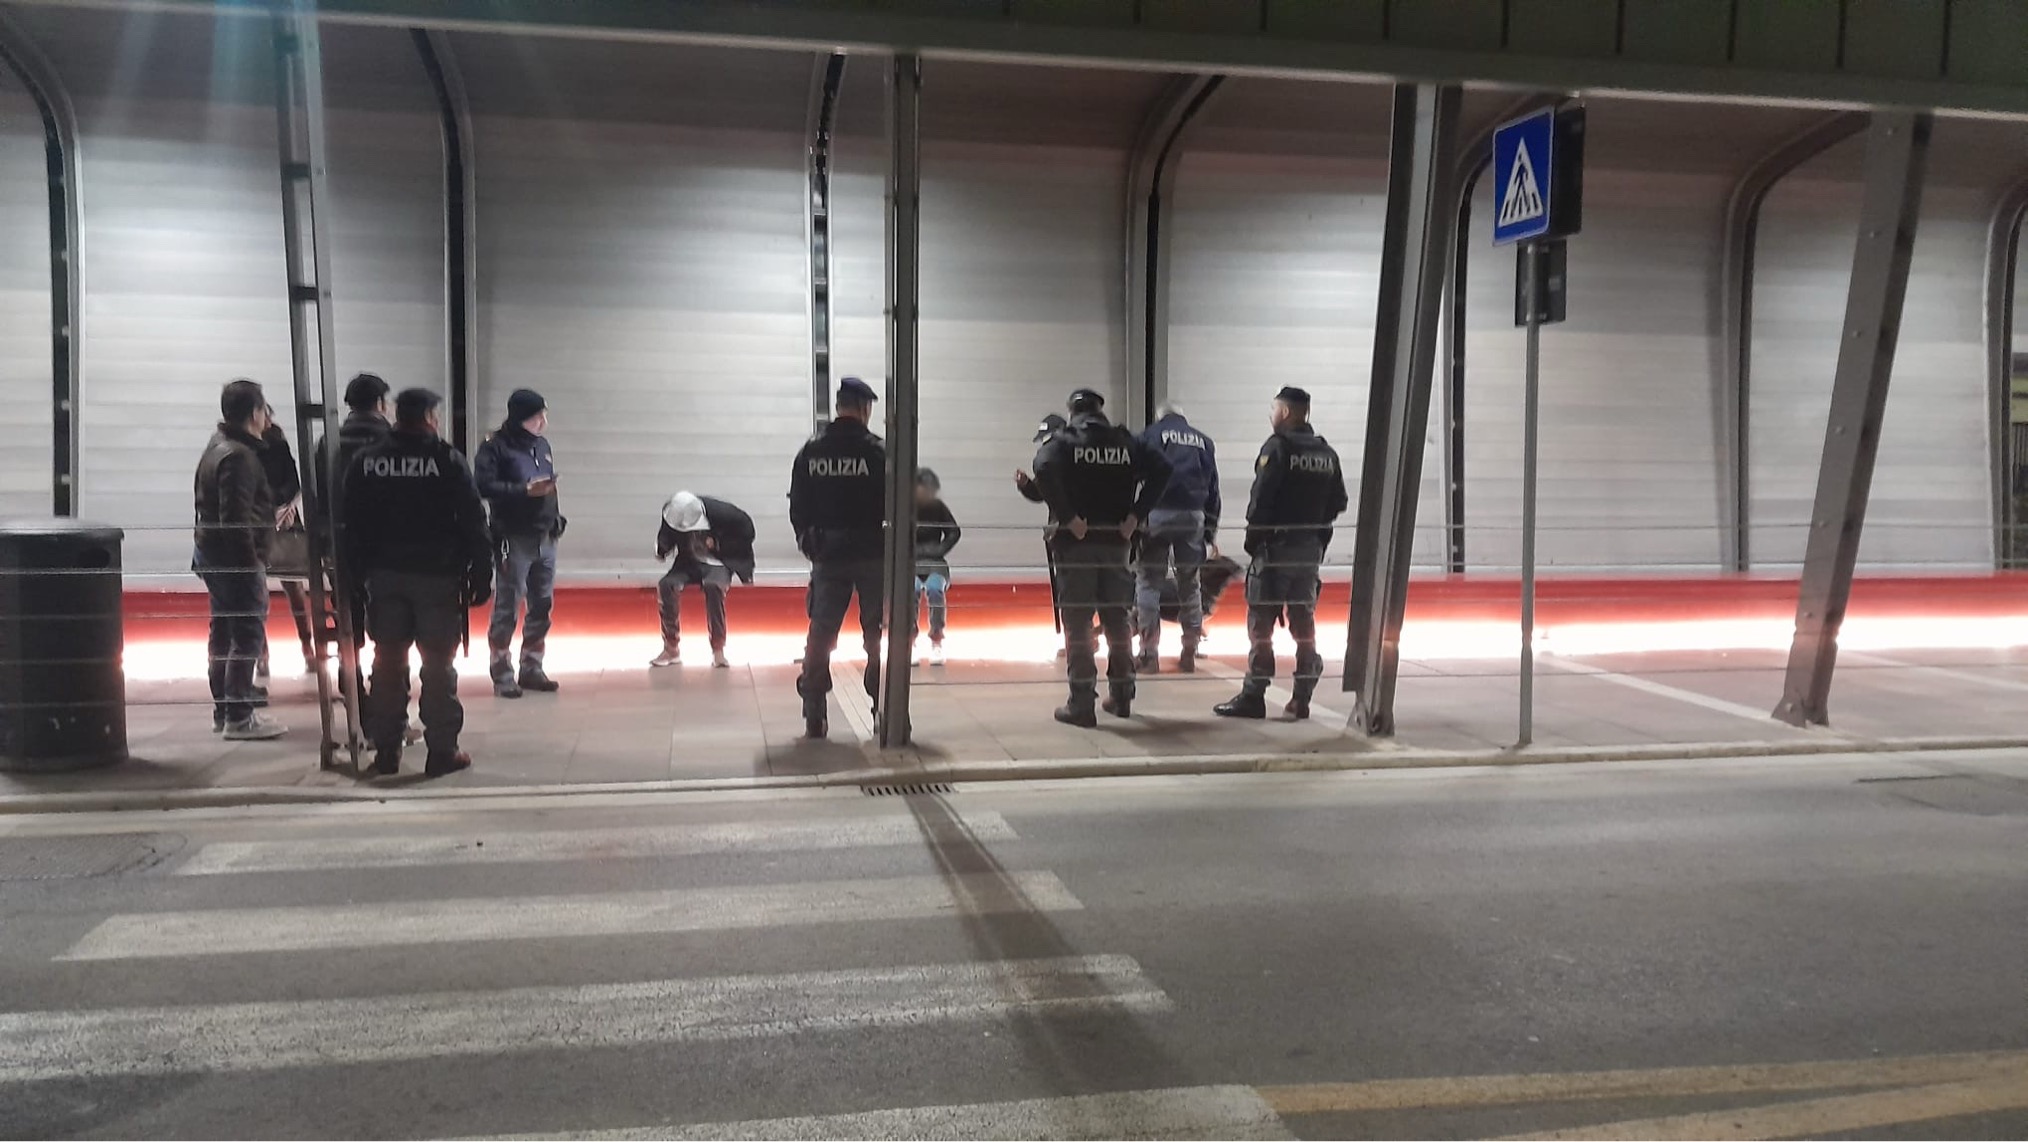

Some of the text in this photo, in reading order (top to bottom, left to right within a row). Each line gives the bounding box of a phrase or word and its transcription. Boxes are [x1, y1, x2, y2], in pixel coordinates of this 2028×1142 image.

[1161, 429, 1206, 451] POLIZIA
[1074, 446, 1131, 465] POLIZIA
[1289, 454, 1334, 475] POLIZIA
[363, 456, 440, 477] POLIZIA
[808, 457, 870, 476] POLIZIA
